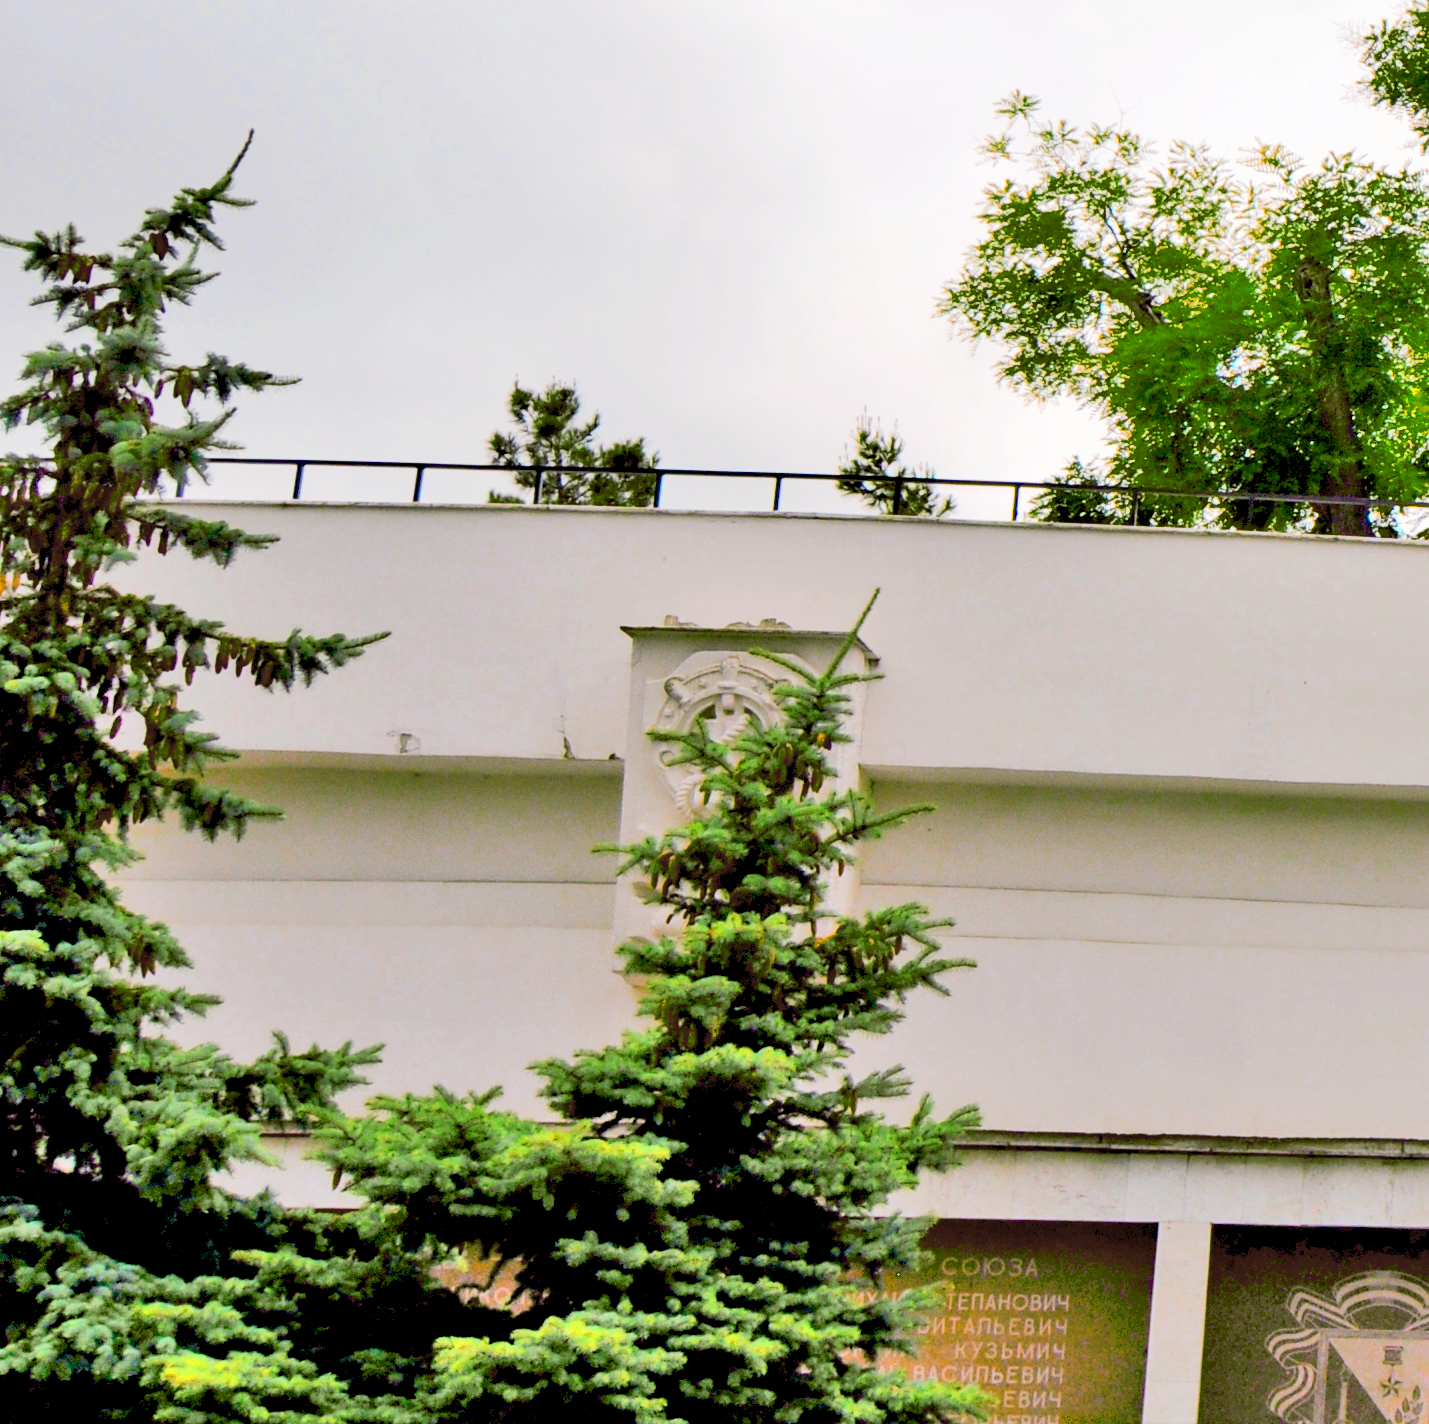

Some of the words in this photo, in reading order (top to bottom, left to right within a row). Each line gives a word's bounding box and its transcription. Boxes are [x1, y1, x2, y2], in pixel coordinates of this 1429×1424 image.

[941, 1256, 1038, 1277] СОЮЗА
[942, 1292, 1070, 1313] ТЕПАНОВИЧ
[954, 1340, 1066, 1361] КУЗЬМИЧ
[911, 1363, 1065, 1385] ВАСИЛЬЕВИЧ
